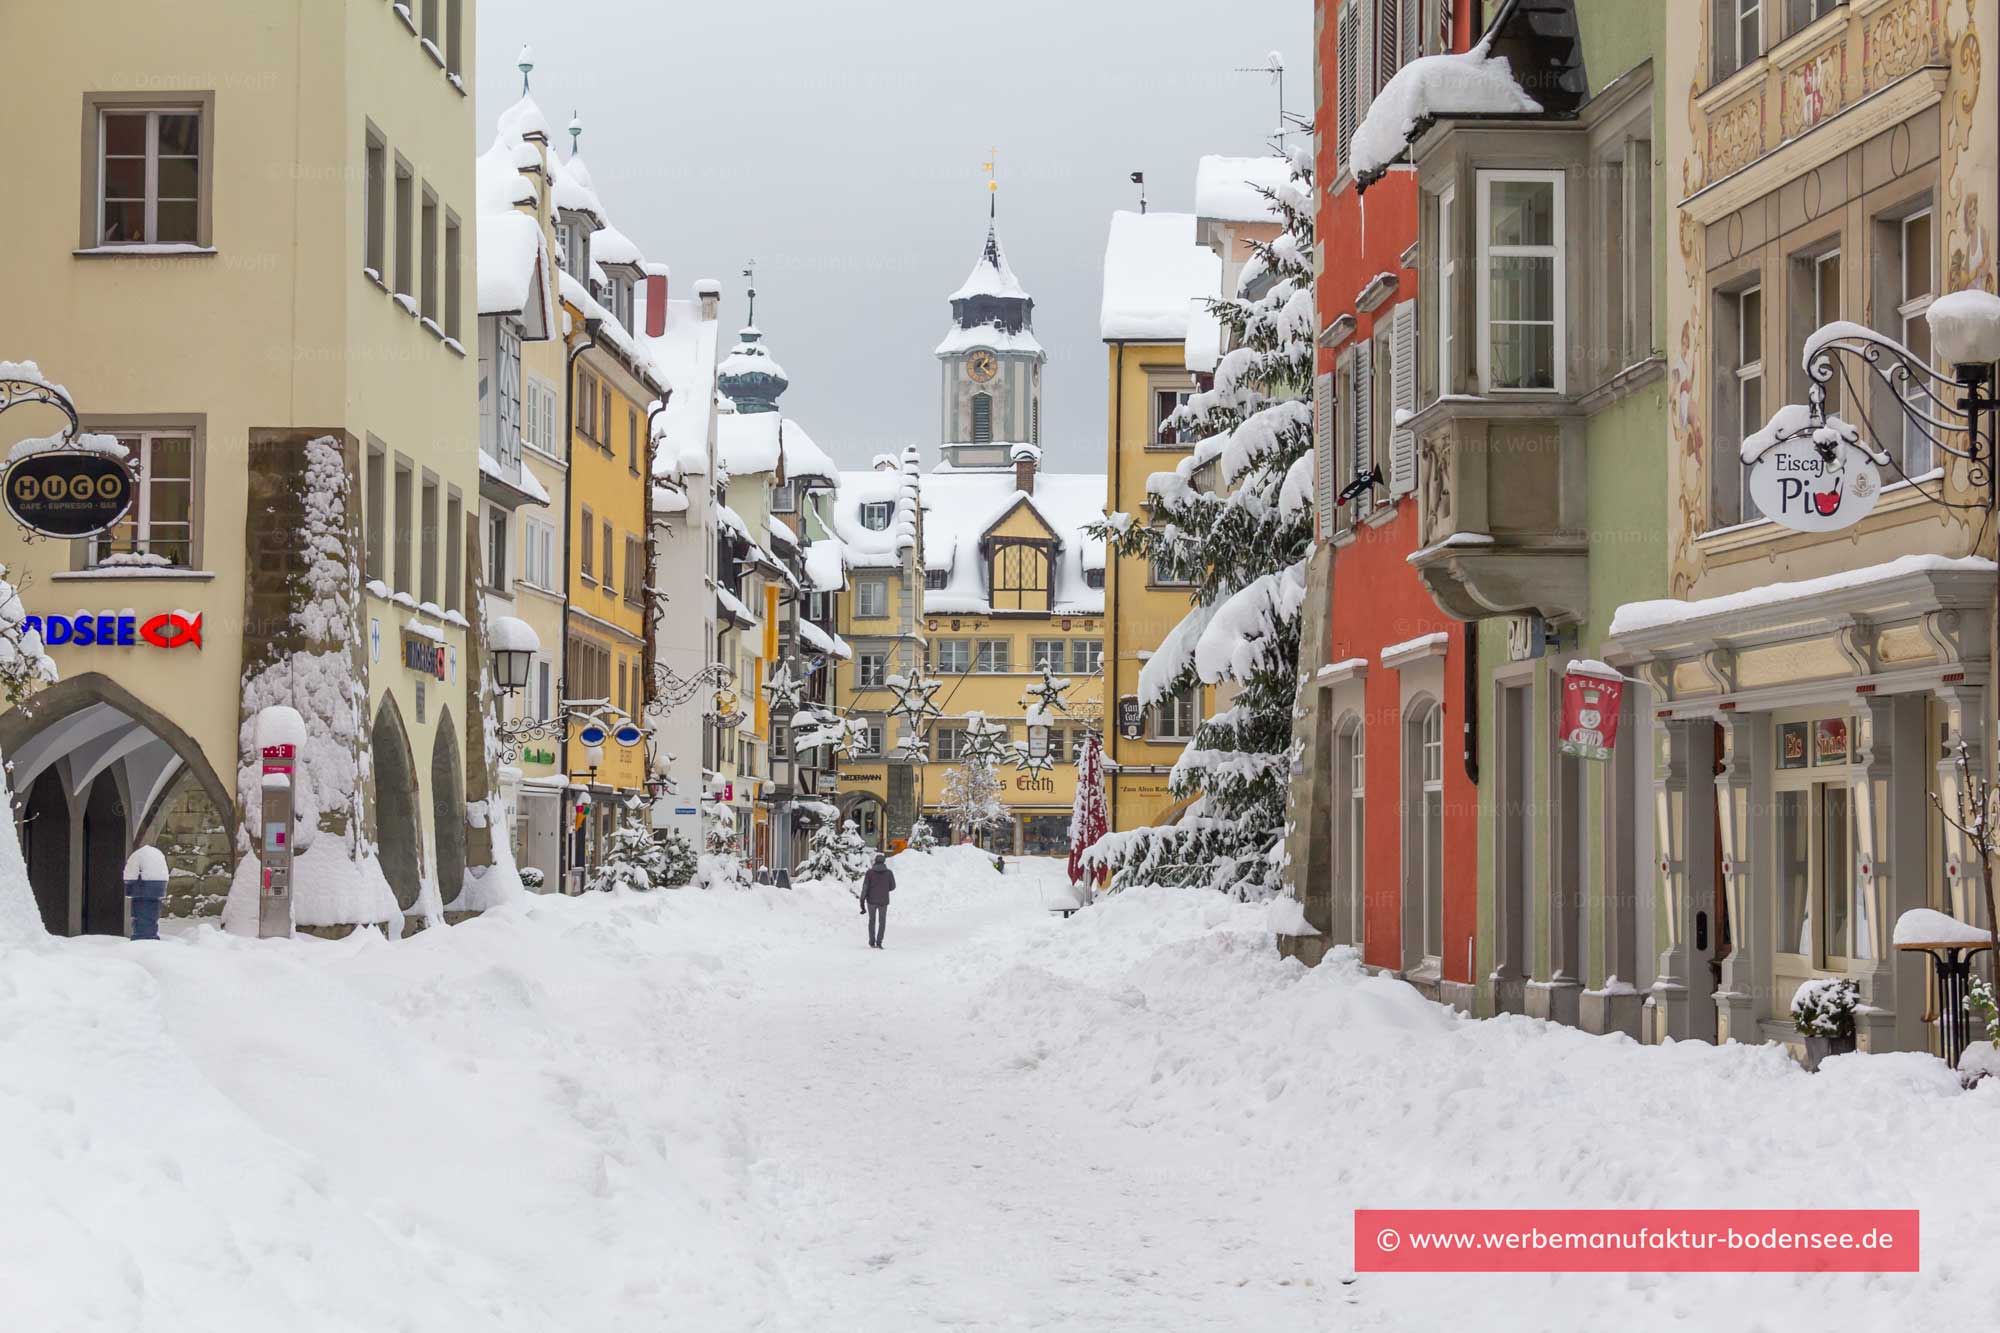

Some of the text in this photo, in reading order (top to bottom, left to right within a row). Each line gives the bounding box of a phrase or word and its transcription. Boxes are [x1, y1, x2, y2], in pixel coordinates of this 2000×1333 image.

[18, 476, 119, 498] HUGO
[48, 501, 93, 510] ESPRESSO
[1568, 680, 1618, 699] GELATI
